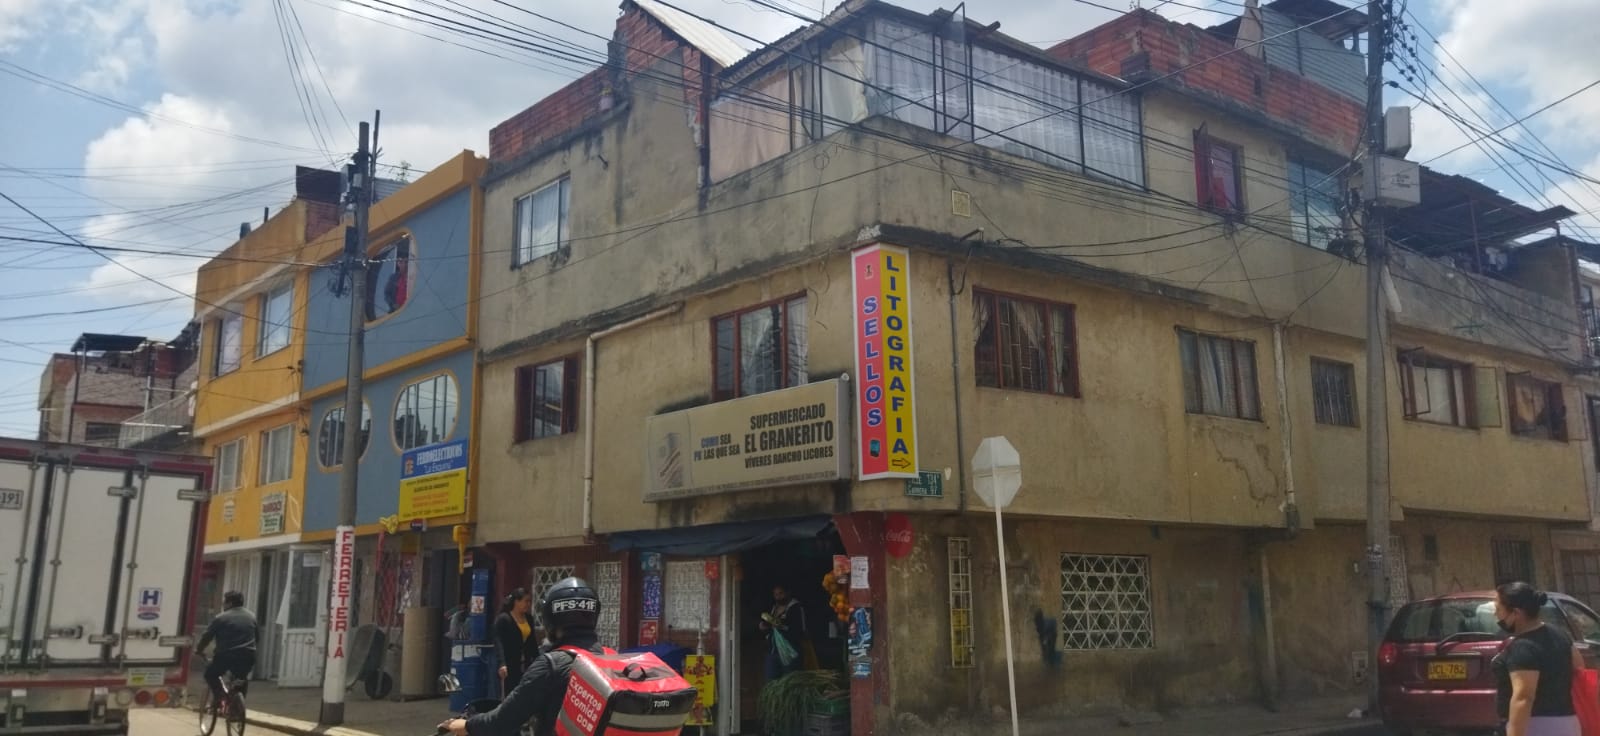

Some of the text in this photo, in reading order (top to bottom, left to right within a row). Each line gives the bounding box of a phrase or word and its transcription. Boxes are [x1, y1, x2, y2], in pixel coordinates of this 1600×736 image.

[863, 296, 882, 427] SELLOS
[886, 256, 909, 455] LITOGRAFIA
[750, 402, 826, 430] SUPERMERCADO
[703, 448, 715, 460] LAS
[716, 446, 728, 459] QUE
[728, 443, 741, 456] SEA
[720, 433, 731, 445] SEA
[744, 420, 834, 454] EL GRANERITO
[803, 445, 834, 461] LICORES
[334, 530, 353, 658] FERRETERIA
[569, 675, 603, 711] Expertos
[570, 694, 598, 722] comida
